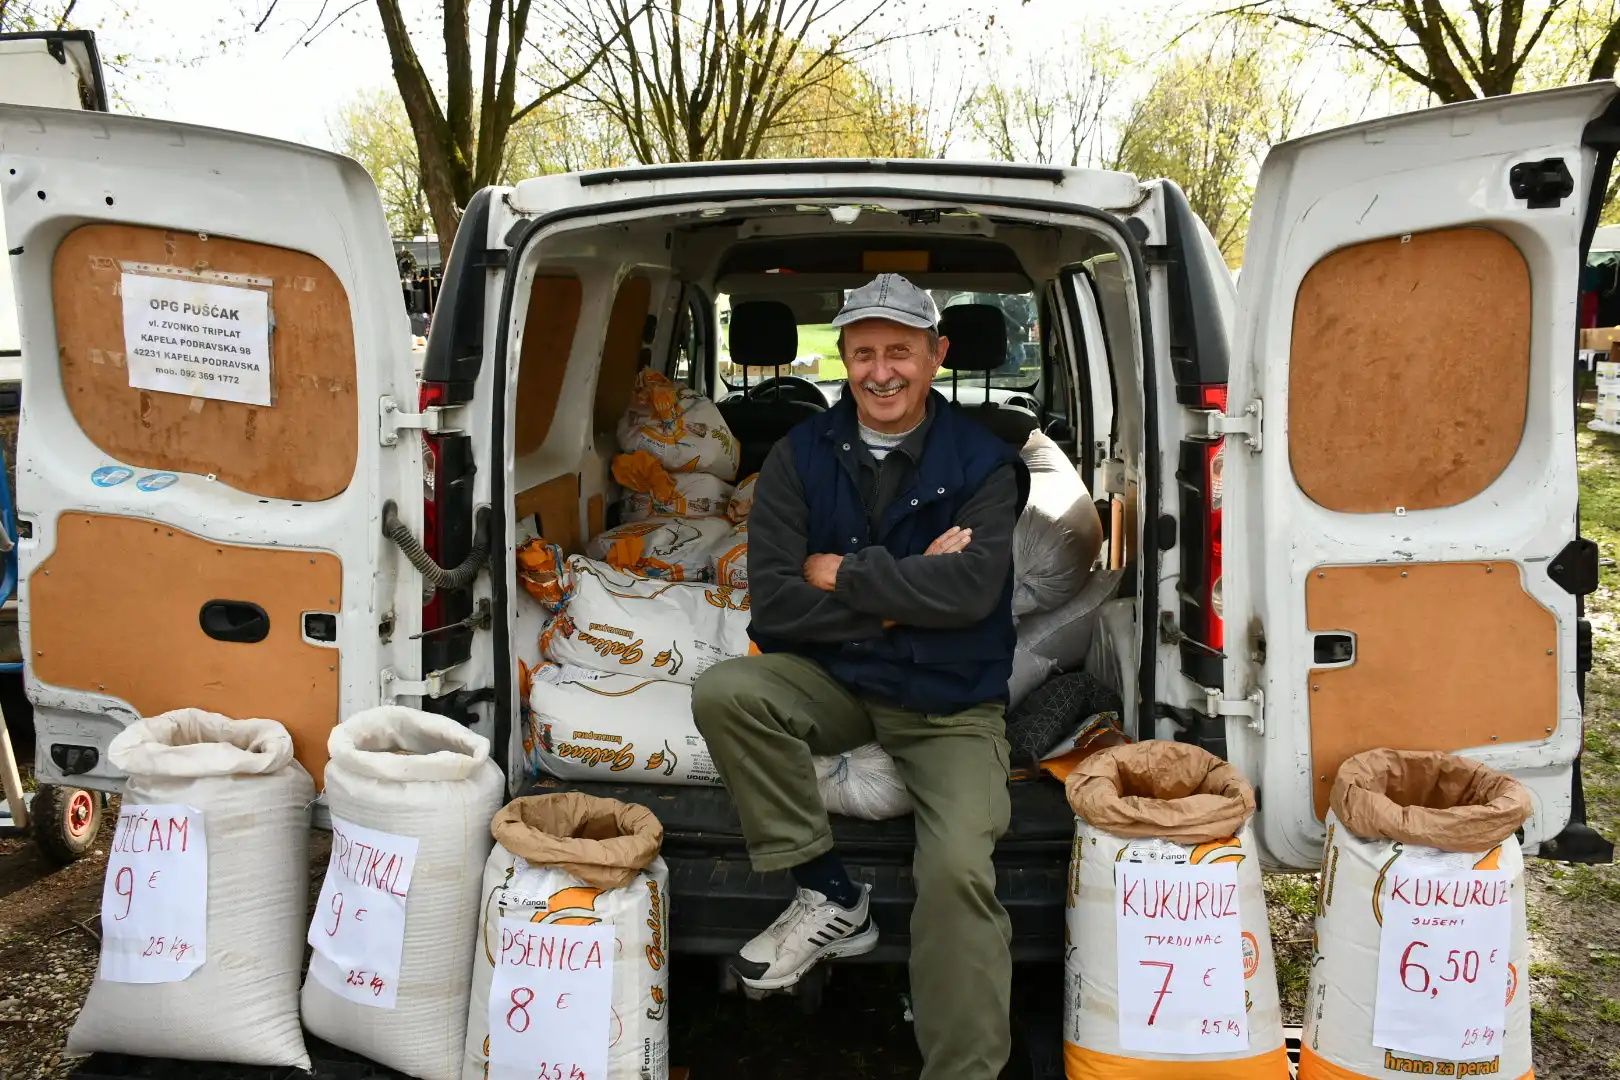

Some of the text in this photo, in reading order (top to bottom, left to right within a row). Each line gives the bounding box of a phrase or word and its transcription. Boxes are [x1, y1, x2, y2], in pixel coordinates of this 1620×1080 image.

[150, 299, 240, 321] OPG PUŠĆAK
[148, 319, 241, 339] vl. ZVONKO TRIPLAT
[140, 333, 251, 355] KAPELA PODRAVSKA 98
[133, 348, 260, 372] 42231 KAPELA PODRAVSKA
[155, 367, 240, 384] mob. 092 369 1772
[578, 632, 643, 664] Galina
[558, 742, 635, 771] Galina
[114, 808, 189, 853] JEČAM
[333, 827, 406, 898] TRITIKAL
[114, 866, 134, 921] 9
[1123, 873, 1237, 921] KUKURUZ
[1391, 875, 1508, 908] KUKURUZ
[325, 892, 344, 937] 9
[1411, 916, 1465, 927] SUŠENI
[142, 936, 164, 957] 25
[501, 928, 602, 971] PŠENICA
[346, 970, 367, 986] 25
[1399, 940, 1479, 999] 6,50
[1139, 960, 1174, 1026] 7
[506, 986, 535, 1033] 8
[1201, 1019, 1222, 1035] 25
[1461, 1028, 1479, 1049] 25
[641, 1037, 651, 1072] Fanon
[1384, 1052, 1500, 1080] hrana za perad
[538, 1061, 564, 1080] 25
